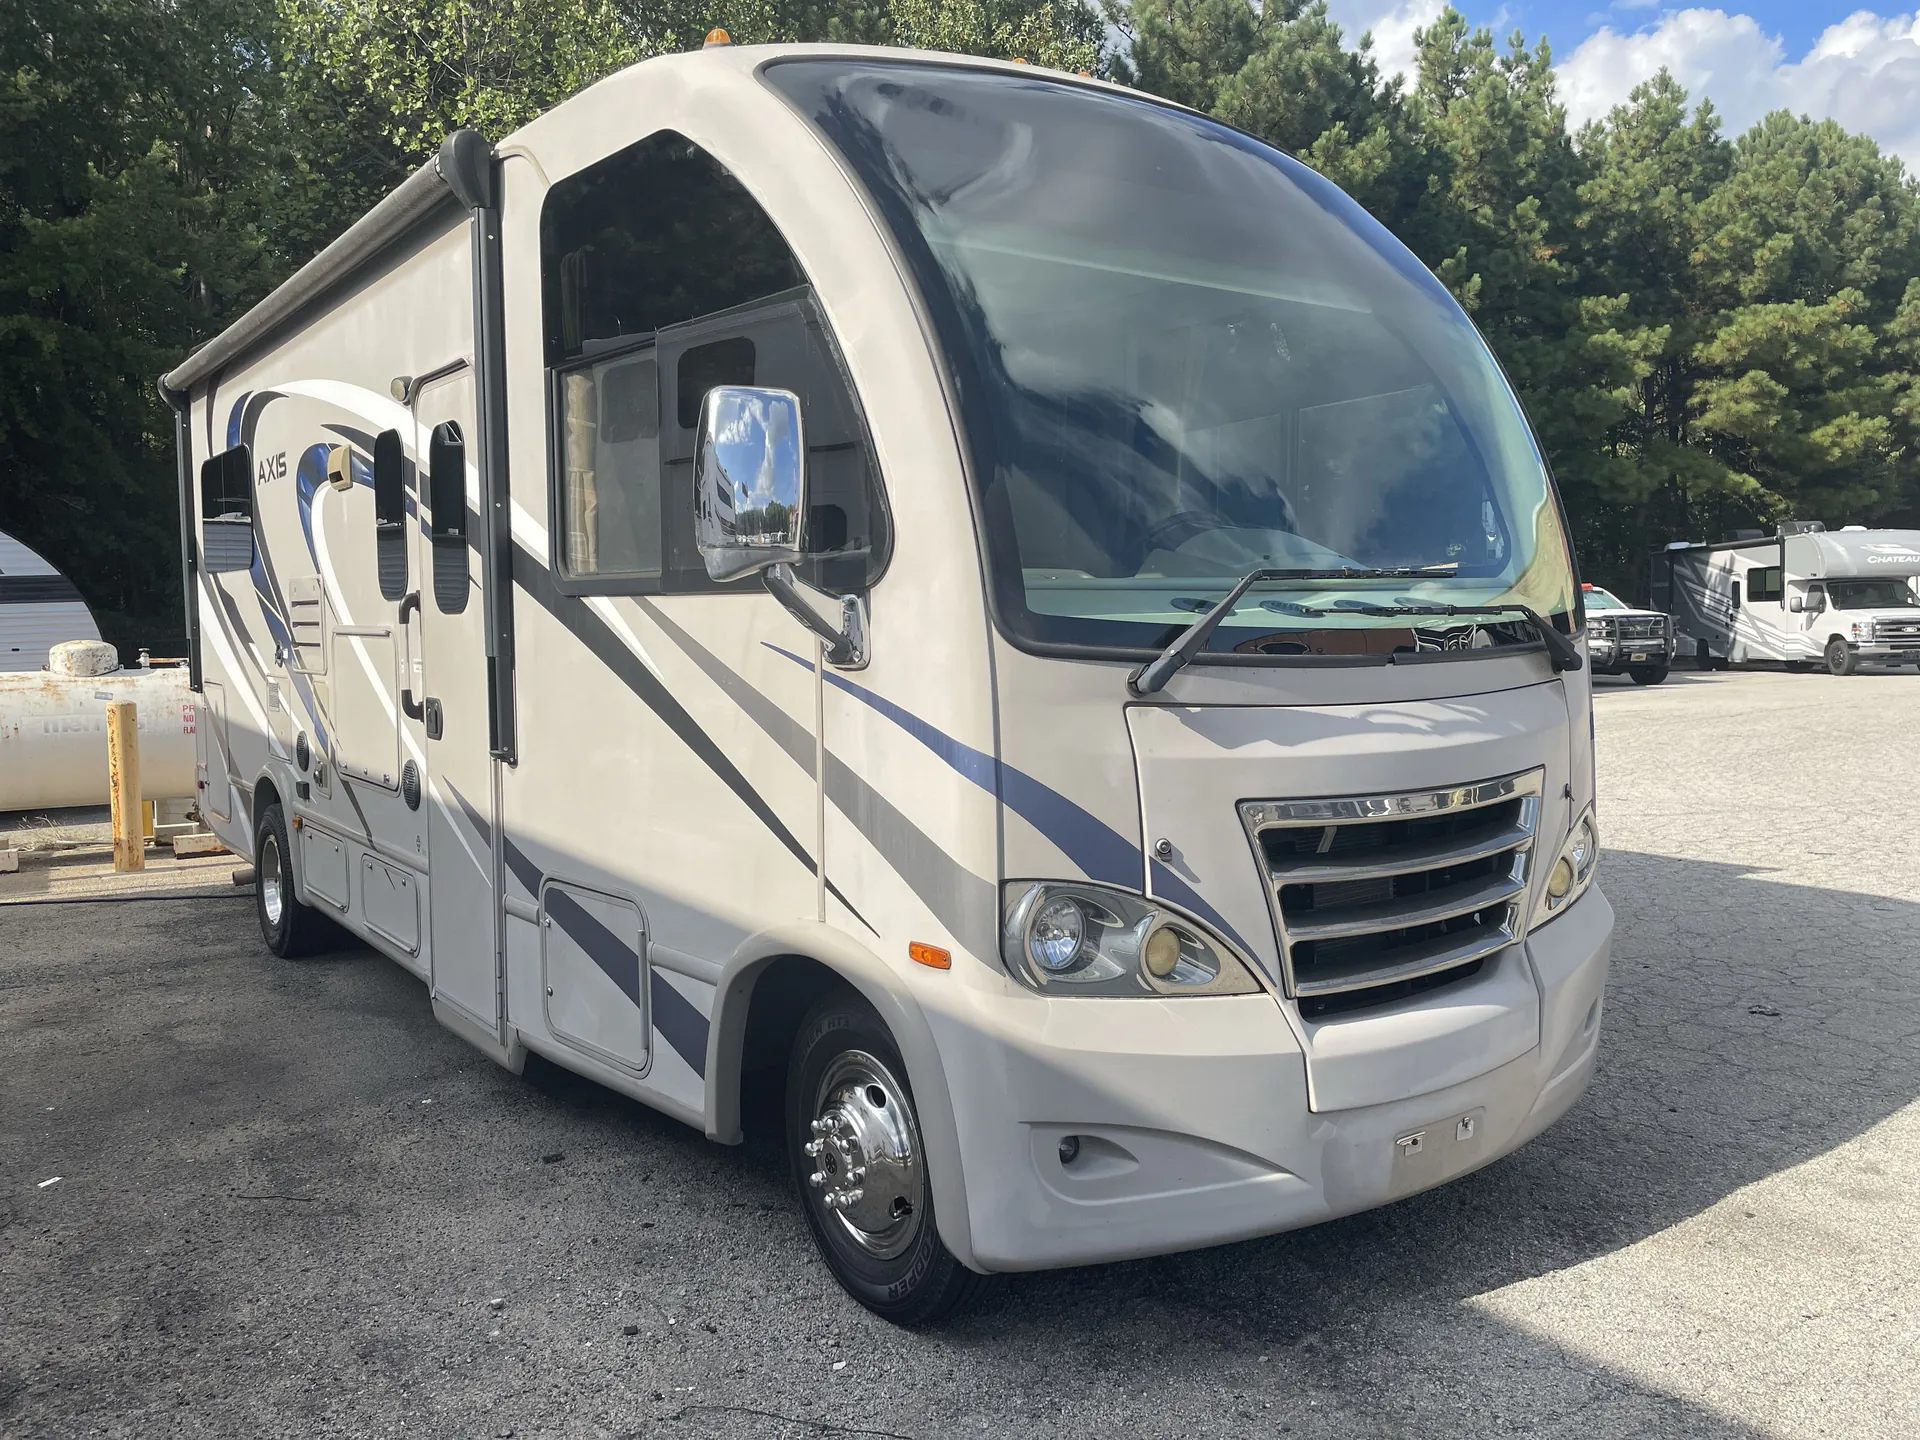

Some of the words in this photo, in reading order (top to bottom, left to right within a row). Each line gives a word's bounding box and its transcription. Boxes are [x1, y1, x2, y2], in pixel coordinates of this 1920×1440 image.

[258, 451, 287, 486] AXIS
[1867, 555, 1920, 564] CHATEAU
[888, 1224, 937, 1300] COOPER
